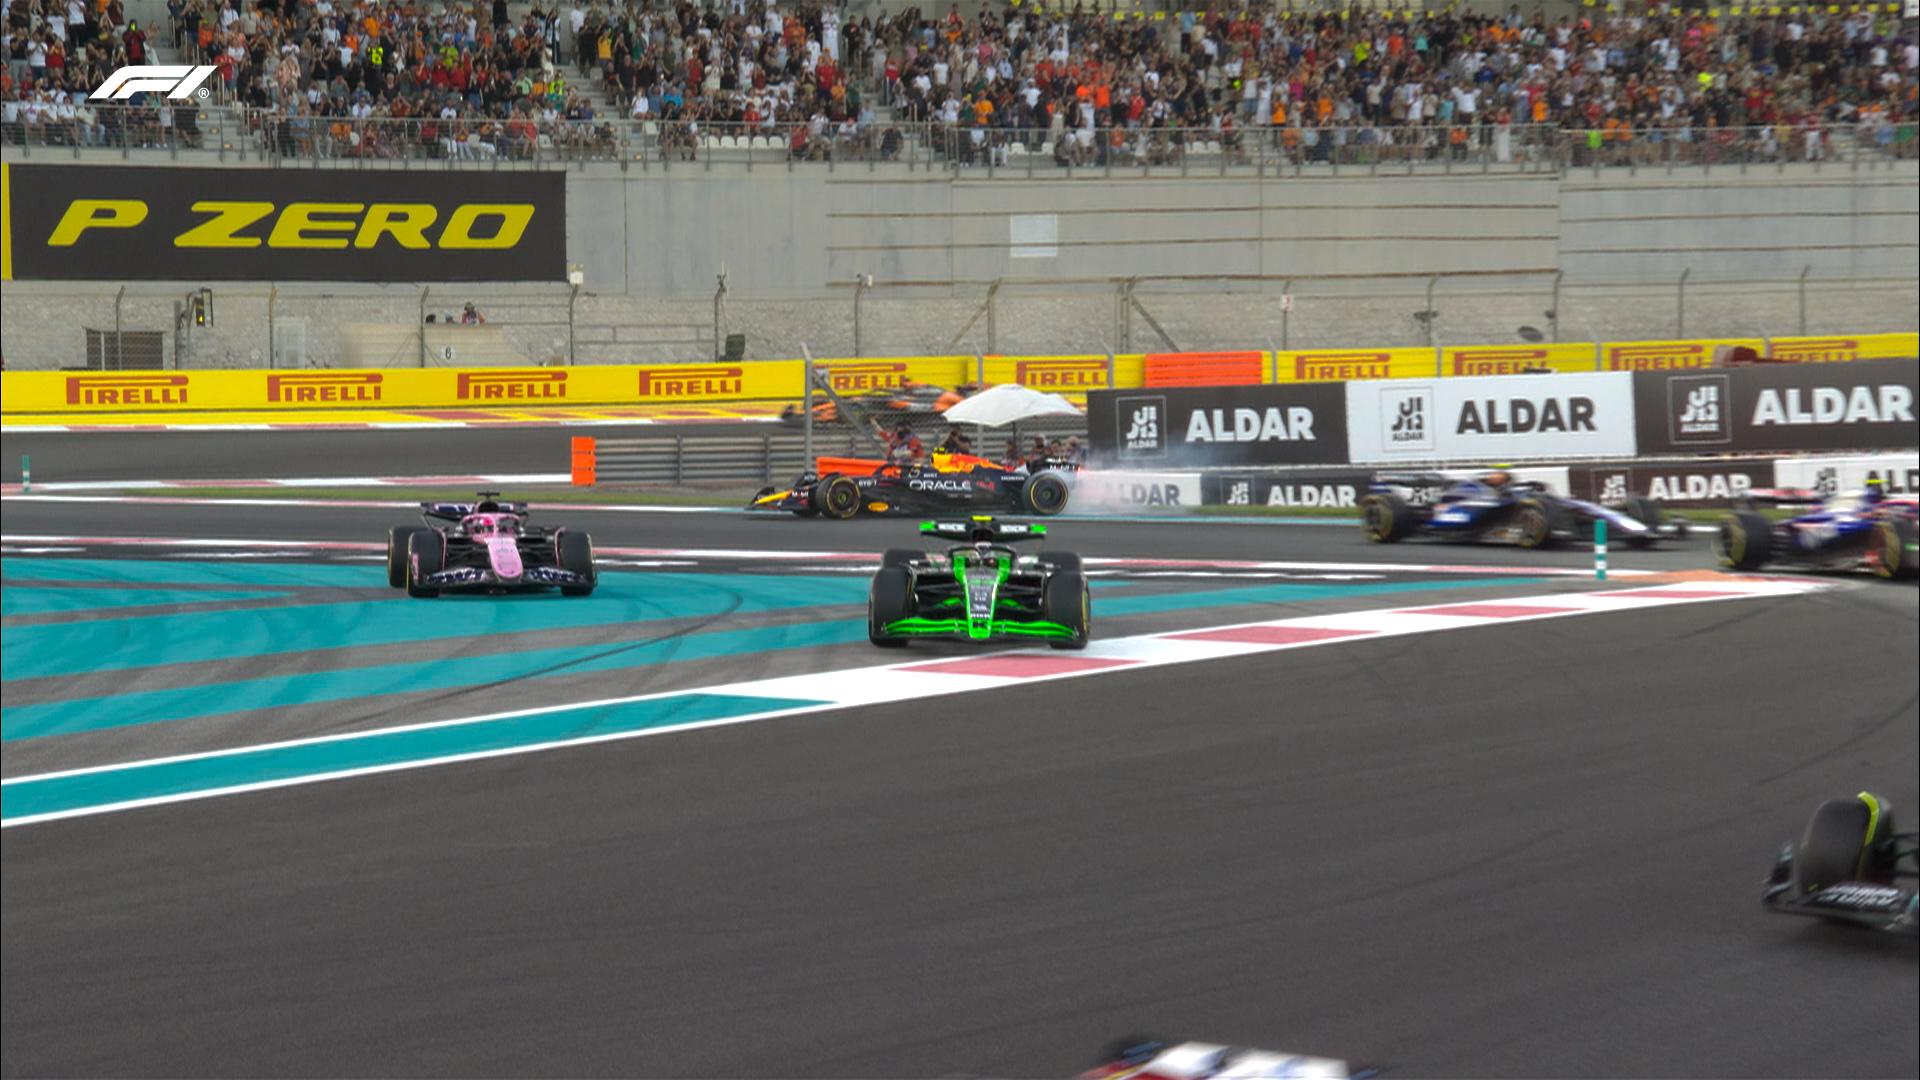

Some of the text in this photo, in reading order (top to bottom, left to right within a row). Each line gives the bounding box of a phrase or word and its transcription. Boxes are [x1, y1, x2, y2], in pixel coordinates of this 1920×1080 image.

[47, 200, 536, 249] P ZERO
[1016, 360, 1108, 385] PIRELL
[1296, 353, 1390, 379] PIRELLI
[66, 375, 188, 404] PIRELLI
[267, 373, 383, 402] PIRELLI
[457, 371, 568, 399] PIRELLI
[639, 367, 743, 395] PIRELLI
[1457, 397, 1598, 434] ALDAR
[1752, 385, 1917, 426] ALDAR
[1185, 406, 1316, 442] ALDAR
[909, 480, 972, 491] ORACLE
[1104, 483, 1181, 507] LDAR
[1267, 485, 1357, 507] ALDAR
